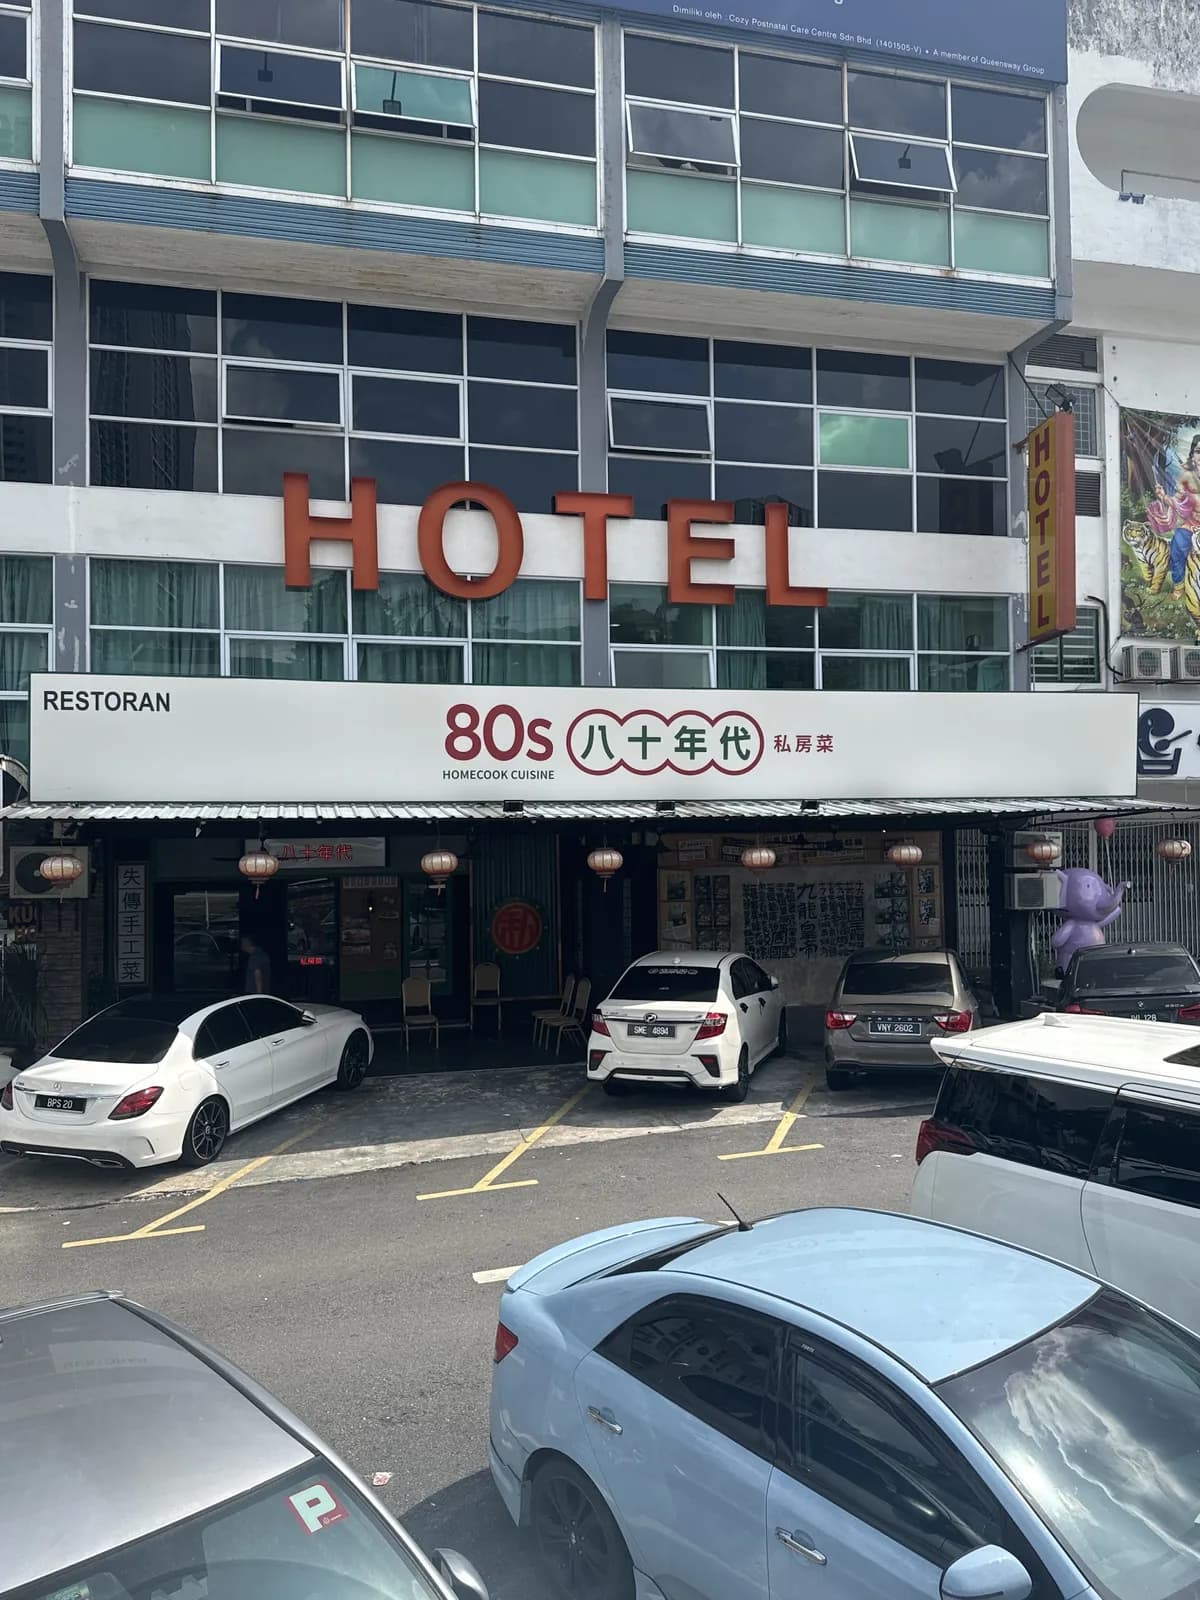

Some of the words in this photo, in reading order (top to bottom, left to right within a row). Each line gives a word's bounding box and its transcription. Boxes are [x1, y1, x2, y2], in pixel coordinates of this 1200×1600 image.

[672, 4, 703, 17] Dimiliki
[704, 11, 722, 20] oleh
[728, 14, 750, 26] Cozy
[751, 18, 788, 32] Postnatal
[790, 24, 810, 35] Care
[811, 28, 837, 40] Centre
[839, 32, 854, 42] Sdn
[856, 34, 872, 45] Bhd
[875, 39, 922, 55] (1401505-V)
[932, 49, 939, 57] A
[940, 51, 971, 62] member
[971, 55, 979, 63] of
[980, 57, 1021, 72] Queensway
[1022, 63, 1045, 75] Group
[283, 472, 828, 607] HOTEL
[1034, 426, 1050, 629] HOTEL
[43, 690, 171, 712] RESTORAN
[444, 703, 554, 762] 80s
[580, 724, 752, 761] 八十年代
[773, 733, 834, 754] 私房菜
[442, 769, 509, 780] HOMECOOK
[511, 769, 555, 780] CUISINE
[282, 843, 353, 862] 八十年代
[121, 867, 142, 981] 失傳手工菜
[877, 1023, 891, 1032] VNY
[894, 1023, 913, 1033] 2602
[47, 1098, 62, 1108] BPS
[62, 1099, 73, 1109] 20
[288, 1484, 337, 1533] P
